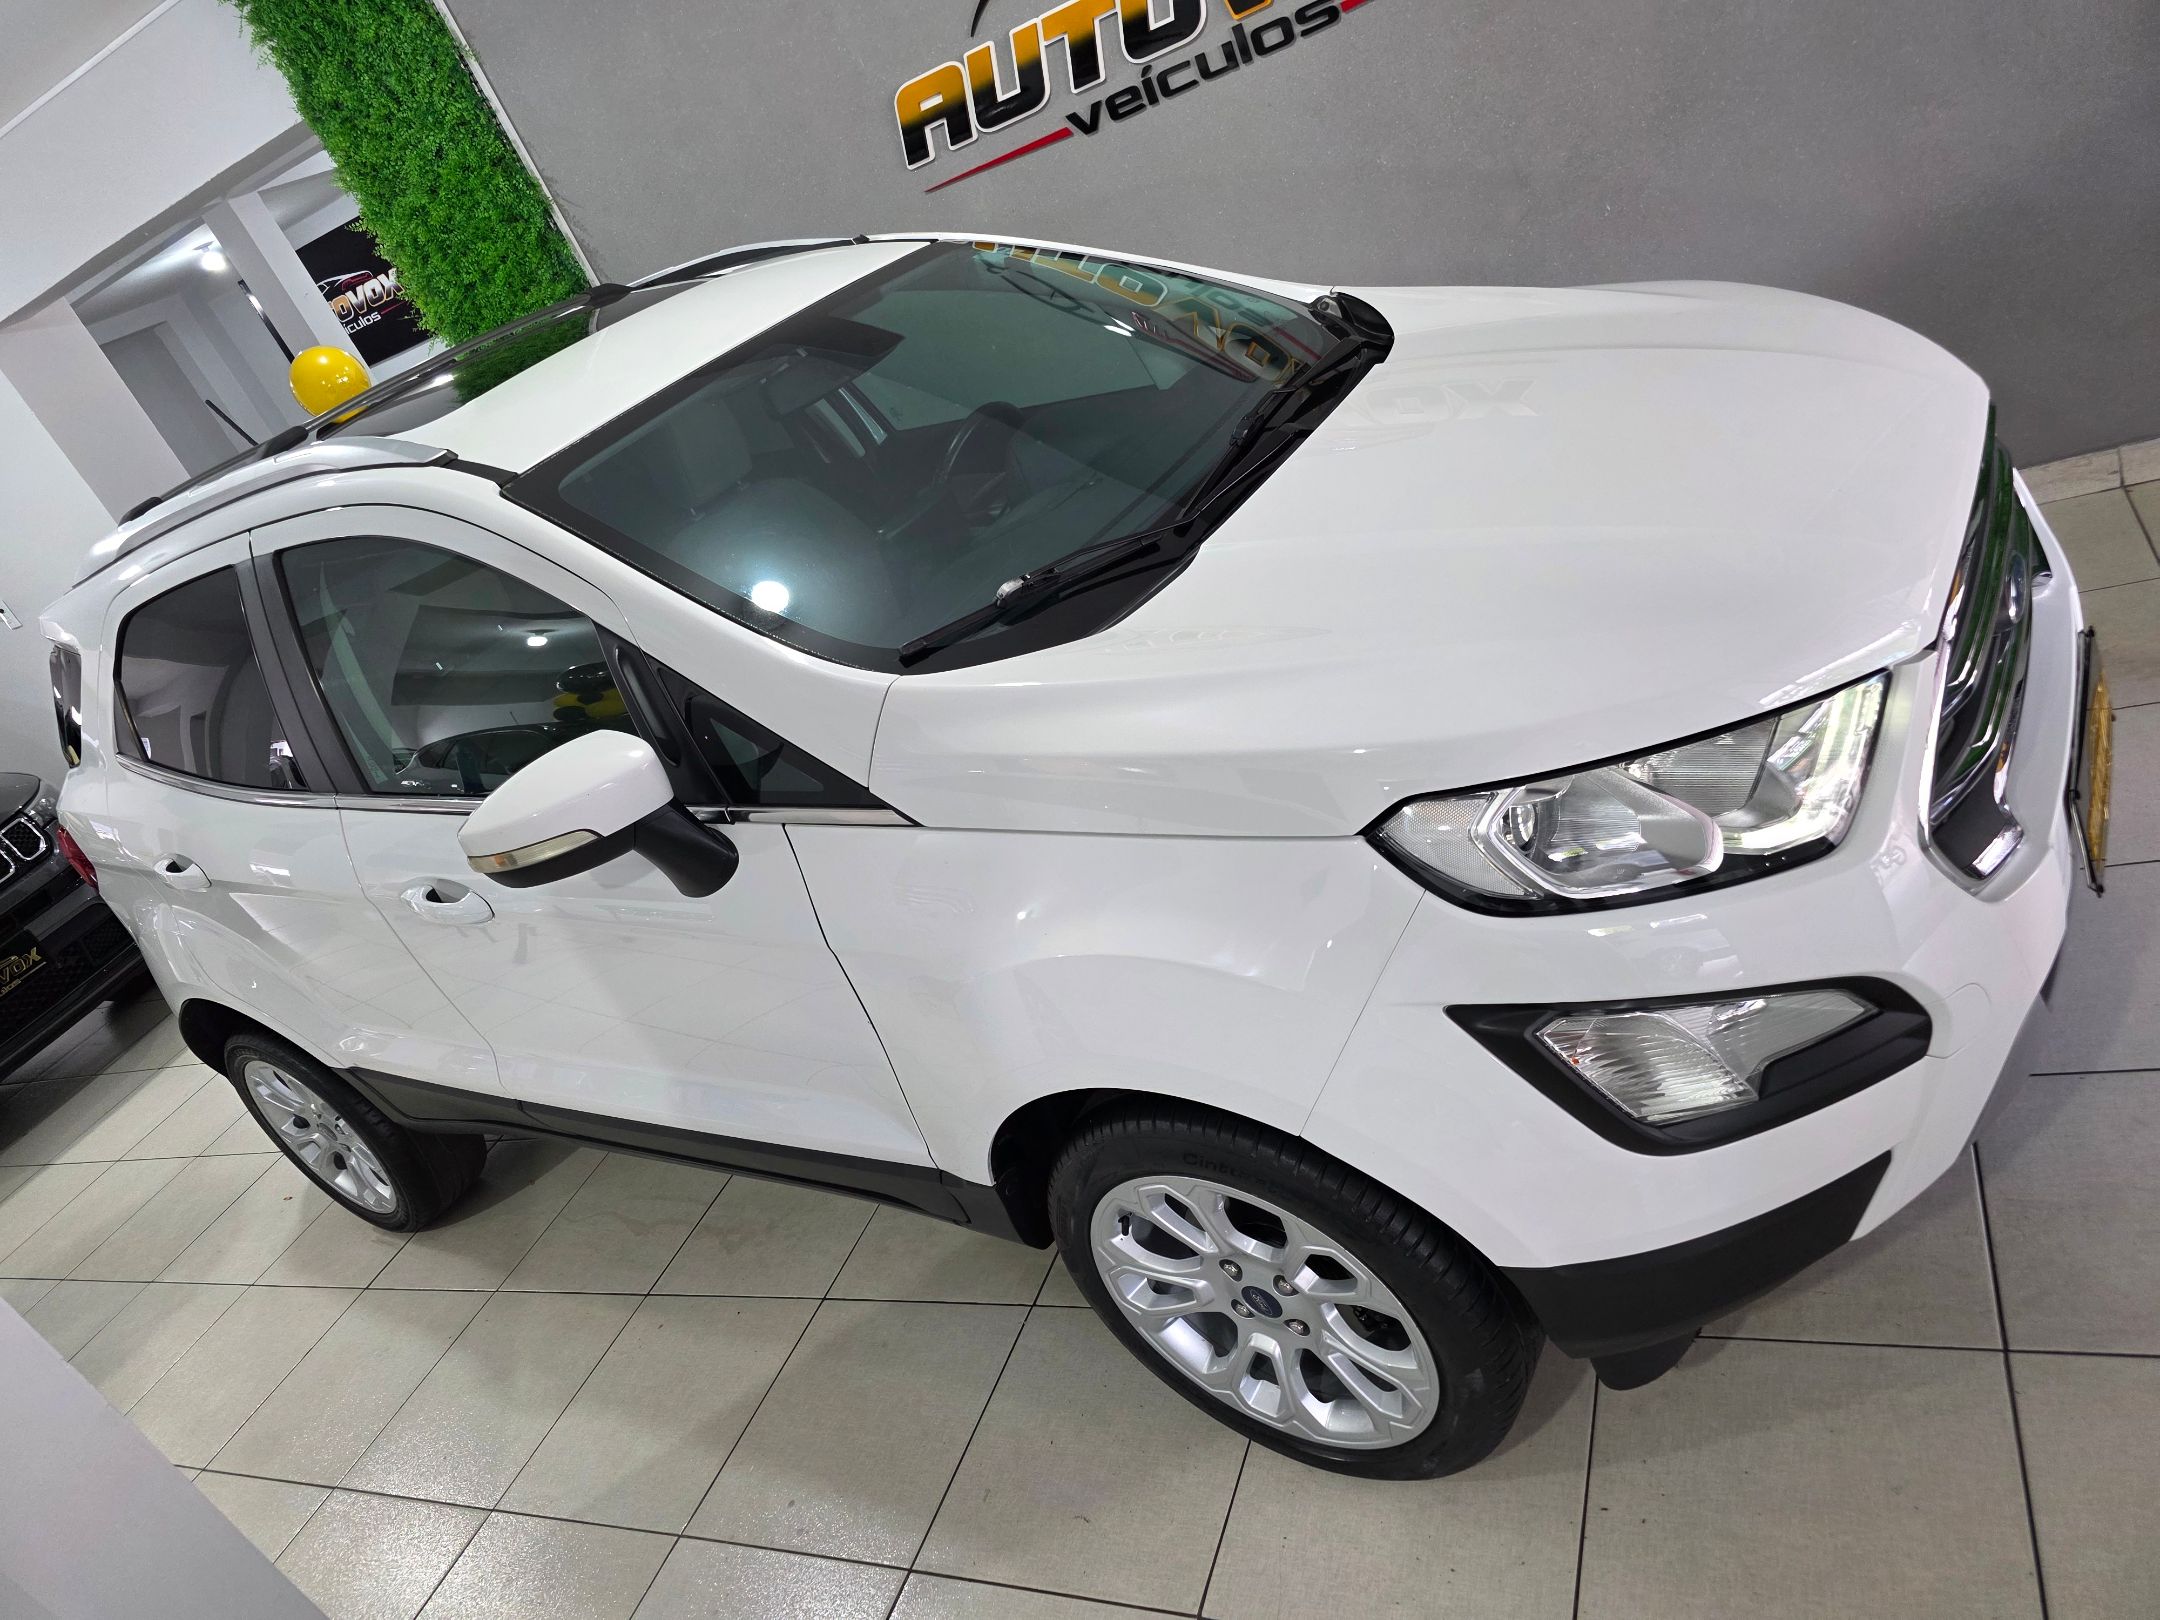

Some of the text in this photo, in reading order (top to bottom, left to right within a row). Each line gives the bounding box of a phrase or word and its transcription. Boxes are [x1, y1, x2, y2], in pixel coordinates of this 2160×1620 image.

[895, 0, 1274, 170] AUTO
[1066, 0, 1342, 136] veículos
[328, 266, 406, 323] OVOX
